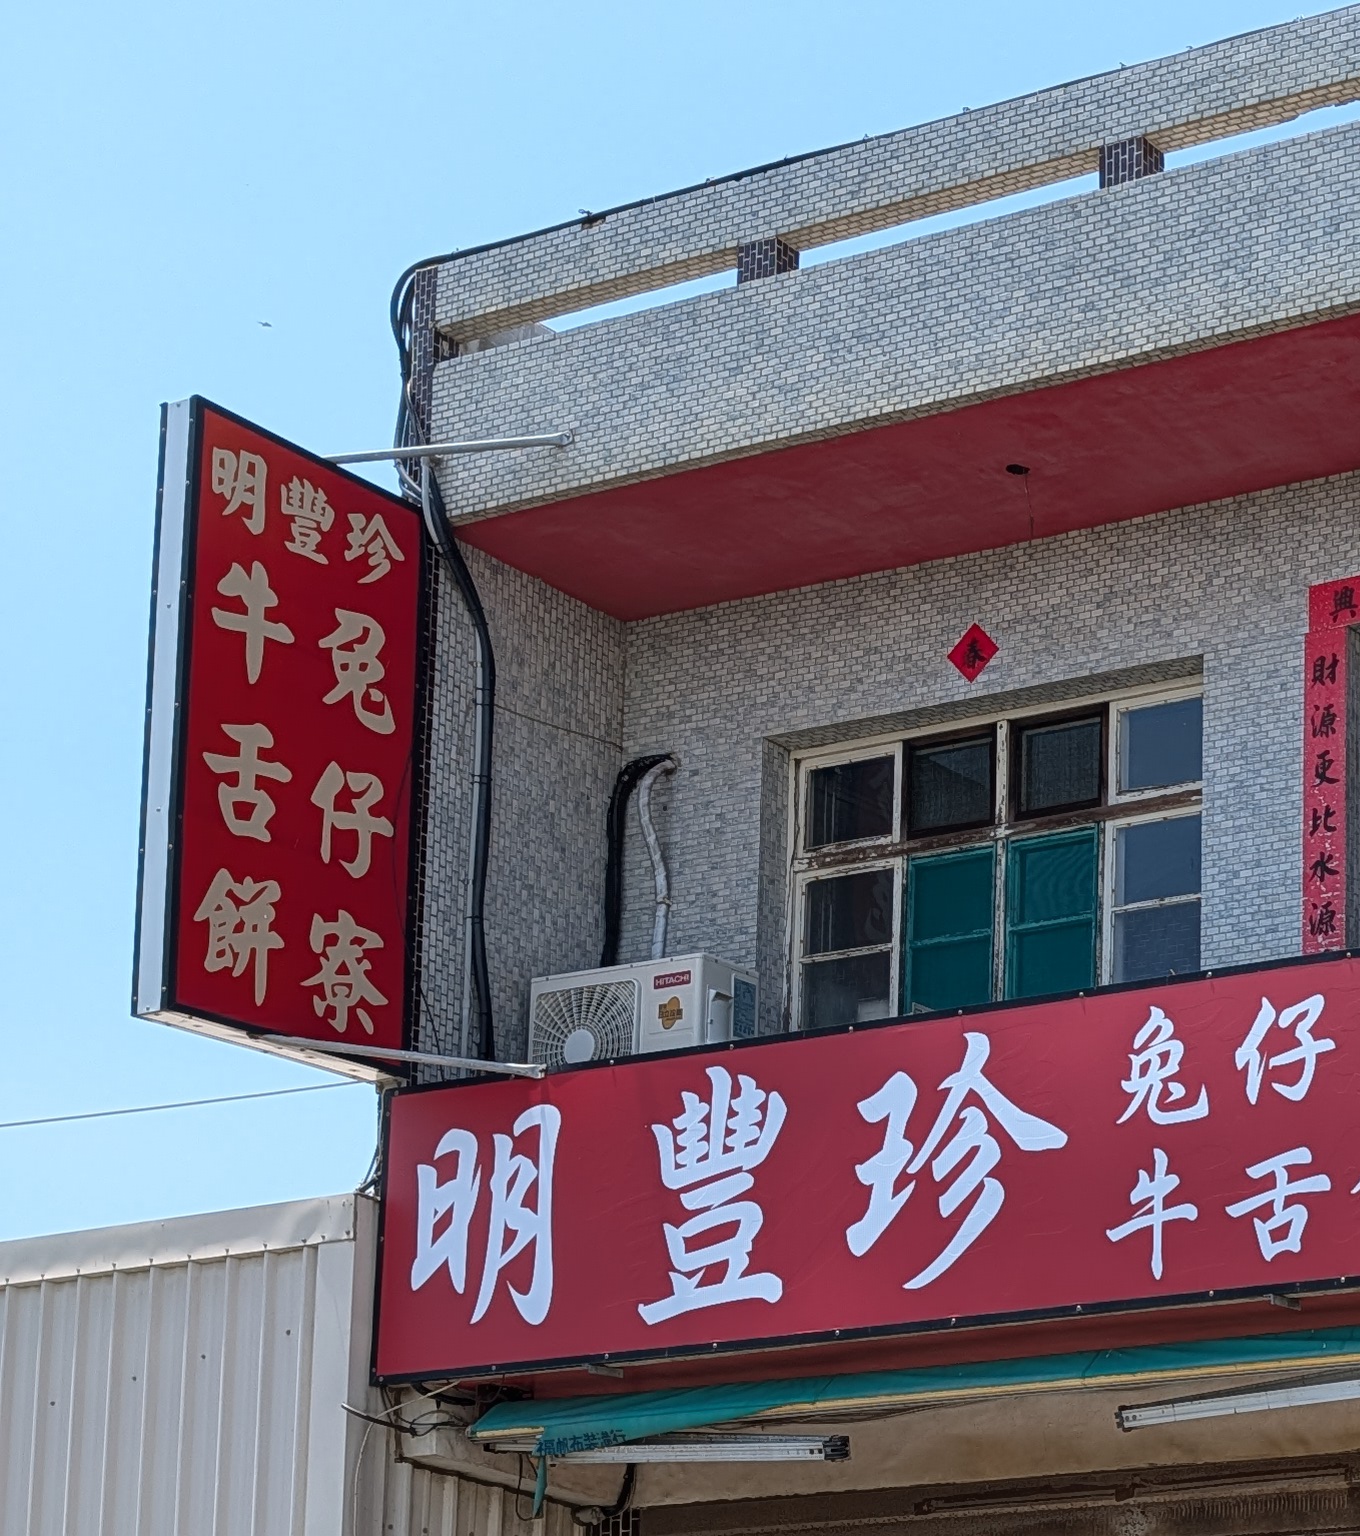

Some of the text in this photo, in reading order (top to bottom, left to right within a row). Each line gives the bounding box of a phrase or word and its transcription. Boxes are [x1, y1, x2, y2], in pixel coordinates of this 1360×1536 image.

[211, 443, 405, 584] 明豐珍
[193, 560, 295, 1007] 牛舌餅
[301, 608, 396, 1035] 兔仔寮
[655, 973, 690, 987] HITACHI
[411, 1031, 1067, 1326] 明豐珍
